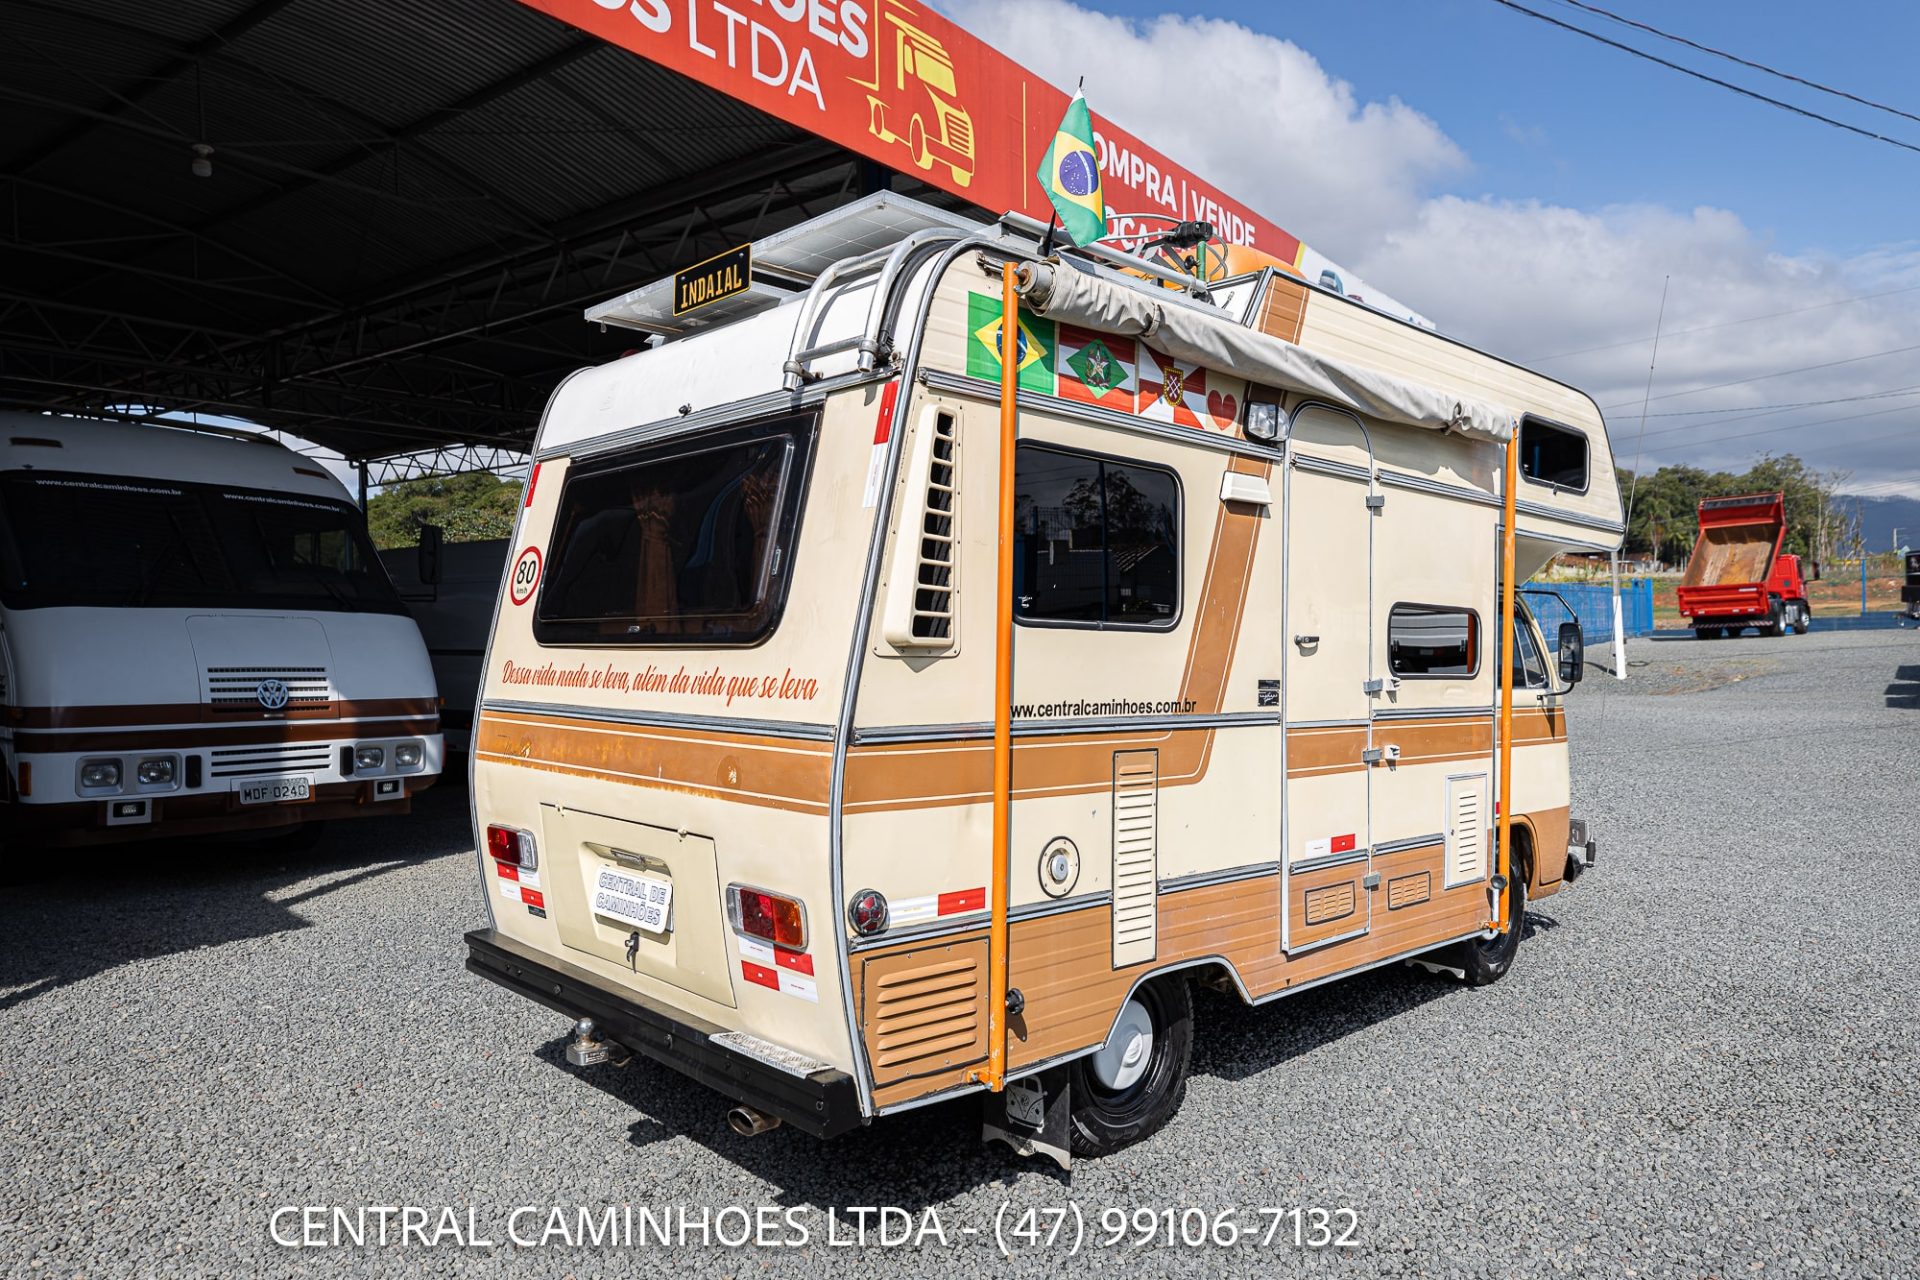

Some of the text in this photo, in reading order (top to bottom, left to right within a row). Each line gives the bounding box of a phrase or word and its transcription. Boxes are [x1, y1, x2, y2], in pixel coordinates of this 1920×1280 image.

[687, 0, 826, 111] LTDA
[1092, 131, 1178, 213] OMPRA
[1191, 190, 1256, 247] VENDE
[681, 264, 742, 309] INDAIAL
[516, 560, 537, 585] 80
[502, 660, 818, 707] Dessa vida nada se leva, além da vida que se leva
[1010, 698, 1197, 718] ww.centralcaminhoes.com.br
[599, 872, 667, 905] CENTRAL DE
[596, 892, 662, 926] CAMINHÕES
